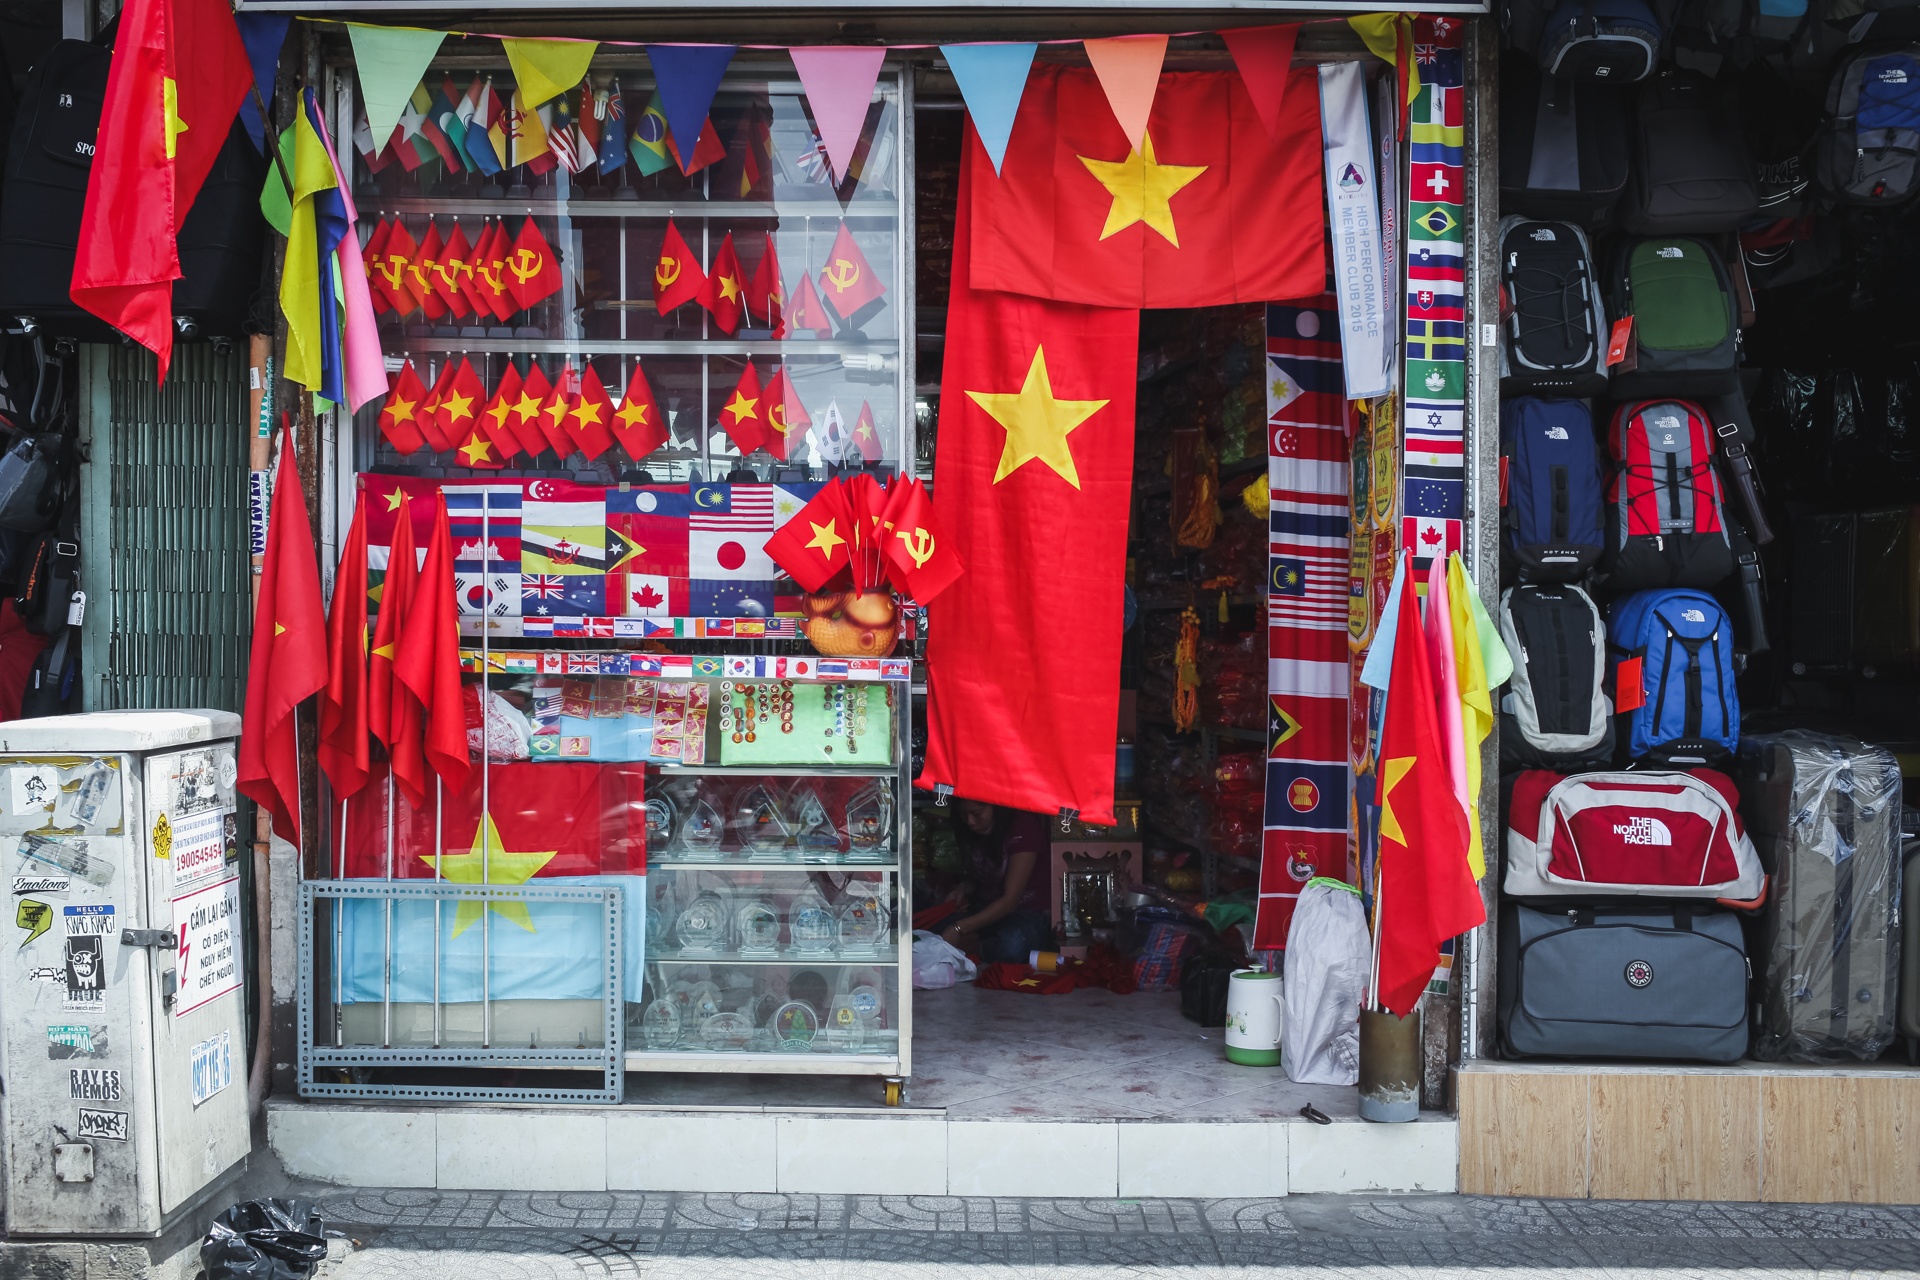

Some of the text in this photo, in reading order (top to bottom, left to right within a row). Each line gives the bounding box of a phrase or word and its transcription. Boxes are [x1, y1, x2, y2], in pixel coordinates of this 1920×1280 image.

[1342, 207, 1363, 333] MEMBER CLUB 2015
[1356, 205, 1378, 338] HIGH PERFORMANCE
[1613, 824, 1651, 836] NORTH
[1629, 816, 1651, 827] THE
[1624, 834, 1651, 845] FACE
[176, 842, 222, 871] 1900545454
[190, 902, 207, 931] CẤM
[207, 903, 219, 926] LẠI
[219, 891, 233, 918] GẦN
[202, 928, 229, 950] CÓ ĐIỆN
[200, 942, 232, 970] NGUY HIỂM
[199, 961, 234, 989] CHẾT NGƯỜI
[70, 1083, 120, 1100] MEMOS
